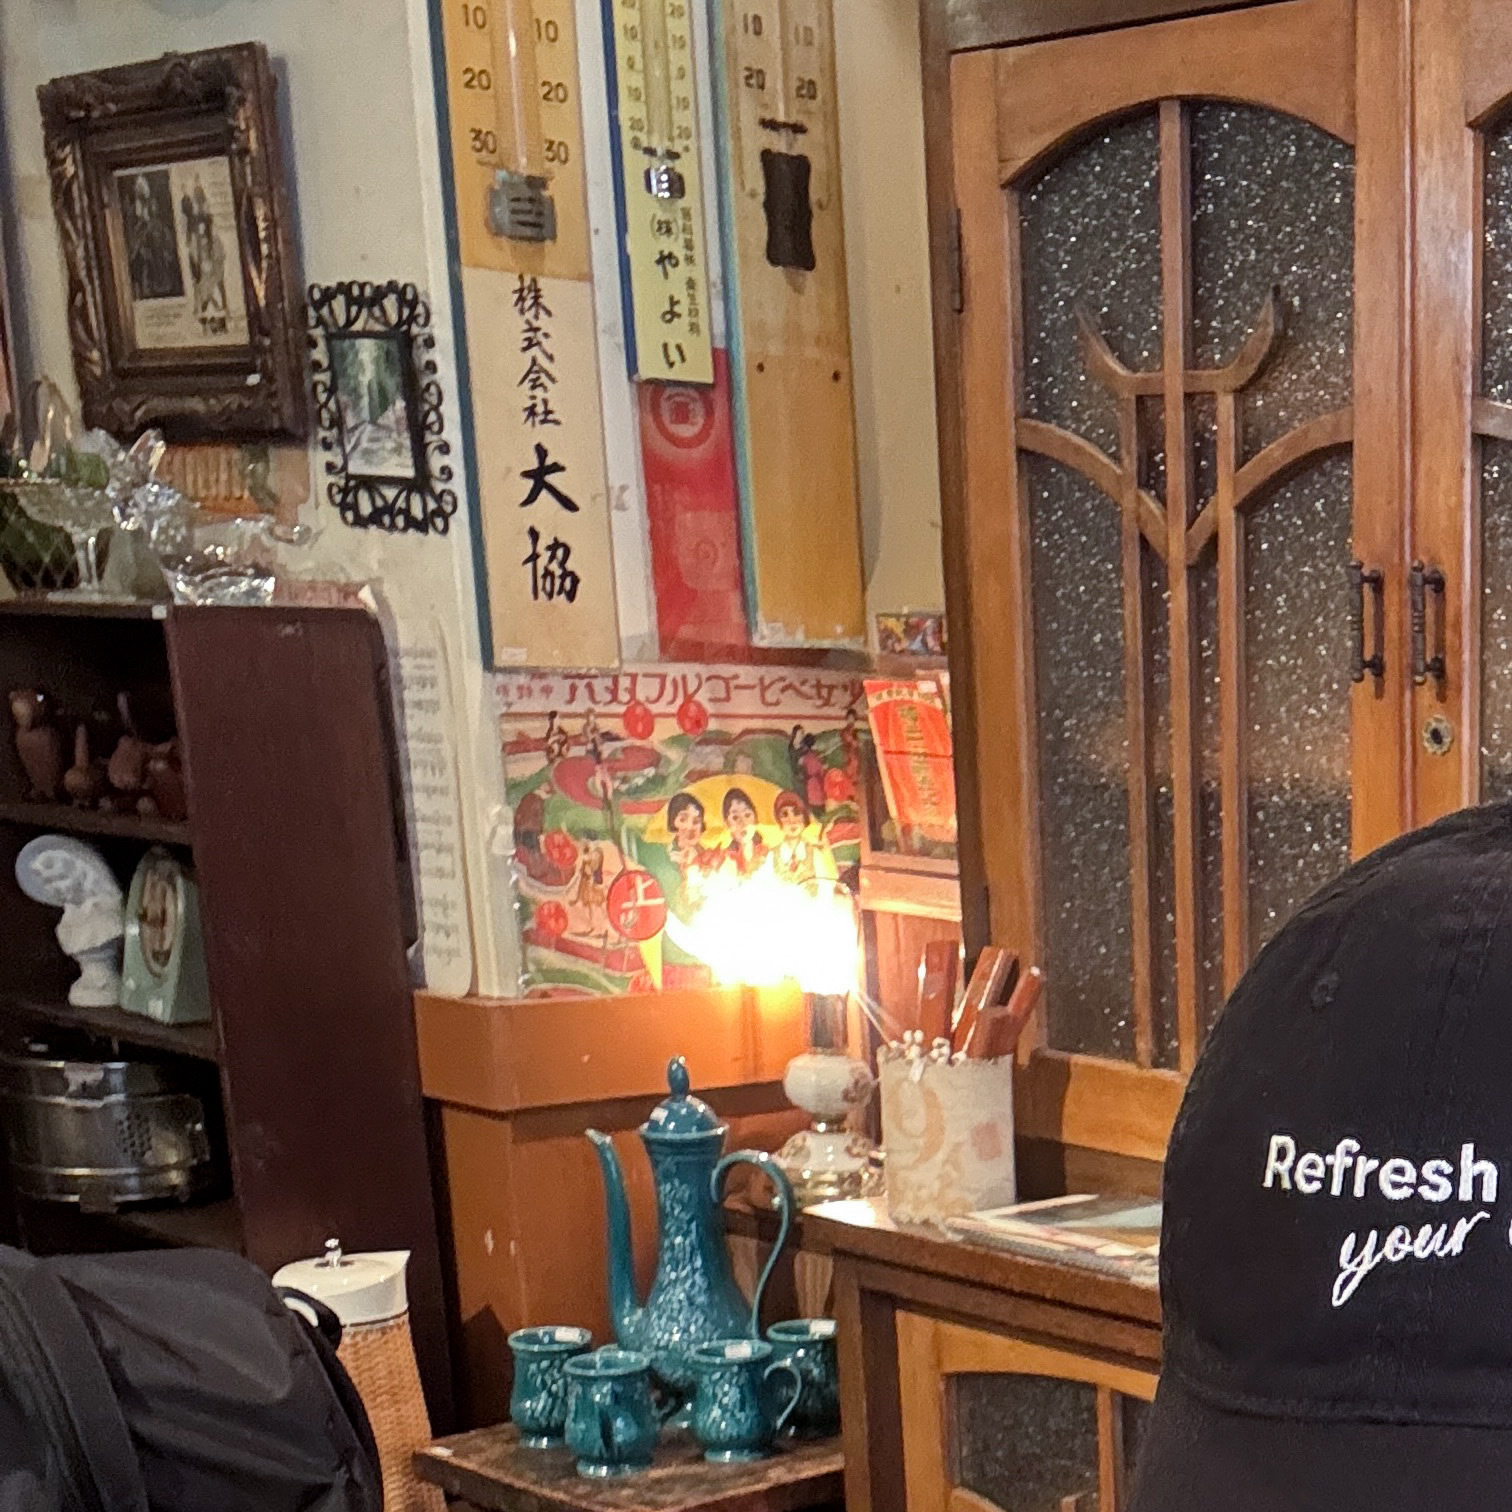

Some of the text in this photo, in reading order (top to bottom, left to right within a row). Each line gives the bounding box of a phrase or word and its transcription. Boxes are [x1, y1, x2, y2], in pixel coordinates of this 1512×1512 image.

[462, 3, 487, 29] 10
[743, 12, 763, 36] 10
[535, 17, 560, 43] 10
[462, 67, 491, 91] 20
[540, 80, 568, 104] 20
[744, 66, 766, 92] 20
[795, 76, 817, 100] 20
[469, 127, 497, 154] 30
[544, 138, 569, 165] 30
[1262, 1134, 1498, 1203] Refresh
[1332, 1211, 1491, 1308] your
